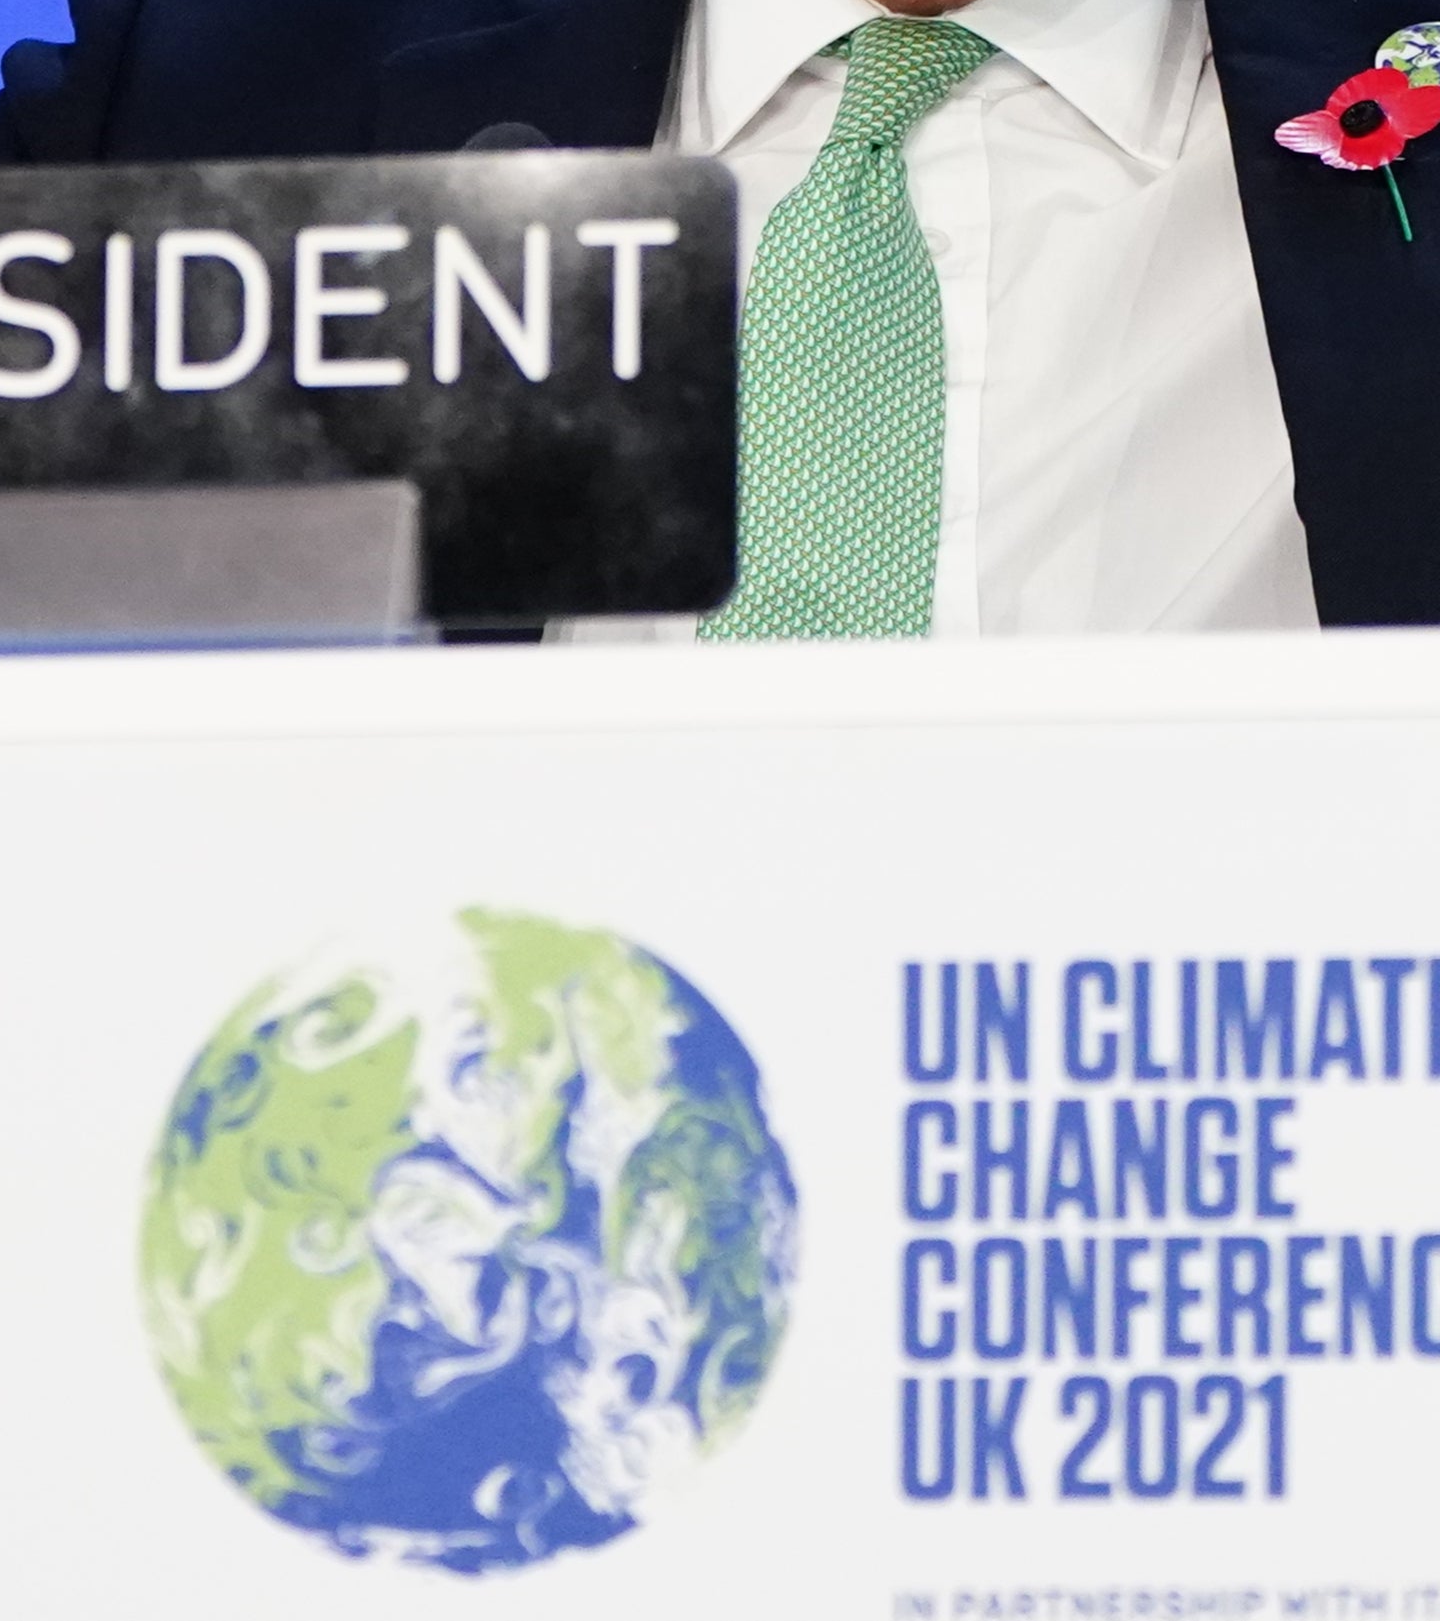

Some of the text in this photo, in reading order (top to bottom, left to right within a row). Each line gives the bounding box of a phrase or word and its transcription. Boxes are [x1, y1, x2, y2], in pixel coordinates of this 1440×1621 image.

[902, 958, 1031, 1084] UN
[901, 1095, 1297, 1222] CHANGE
[900, 1372, 1288, 1501] UK 2021
[893, 1588, 937, 1621] IN
[951, 1585, 1266, 1621] PARTNERSHIP
[1278, 1585, 1389, 1620] WITH
